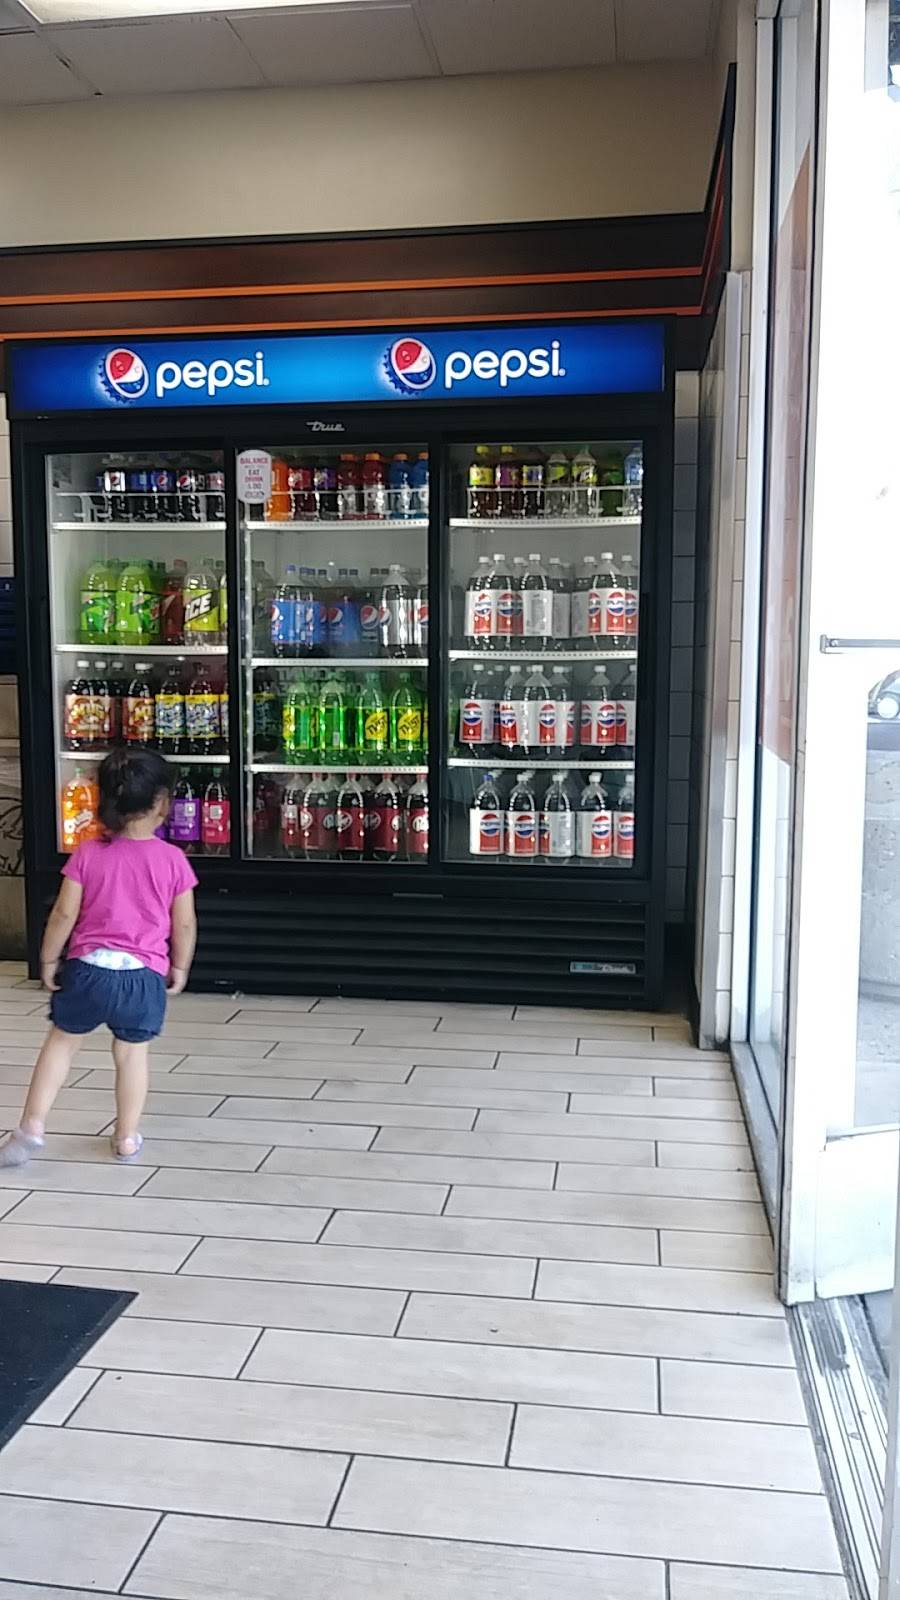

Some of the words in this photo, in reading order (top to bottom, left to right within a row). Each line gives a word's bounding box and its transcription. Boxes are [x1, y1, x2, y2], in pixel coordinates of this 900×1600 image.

[156, 351, 264, 397] pepsi
[445, 340, 560, 389] pepsi
[306, 421, 345, 432] True
[184, 592, 212, 623] ICE
